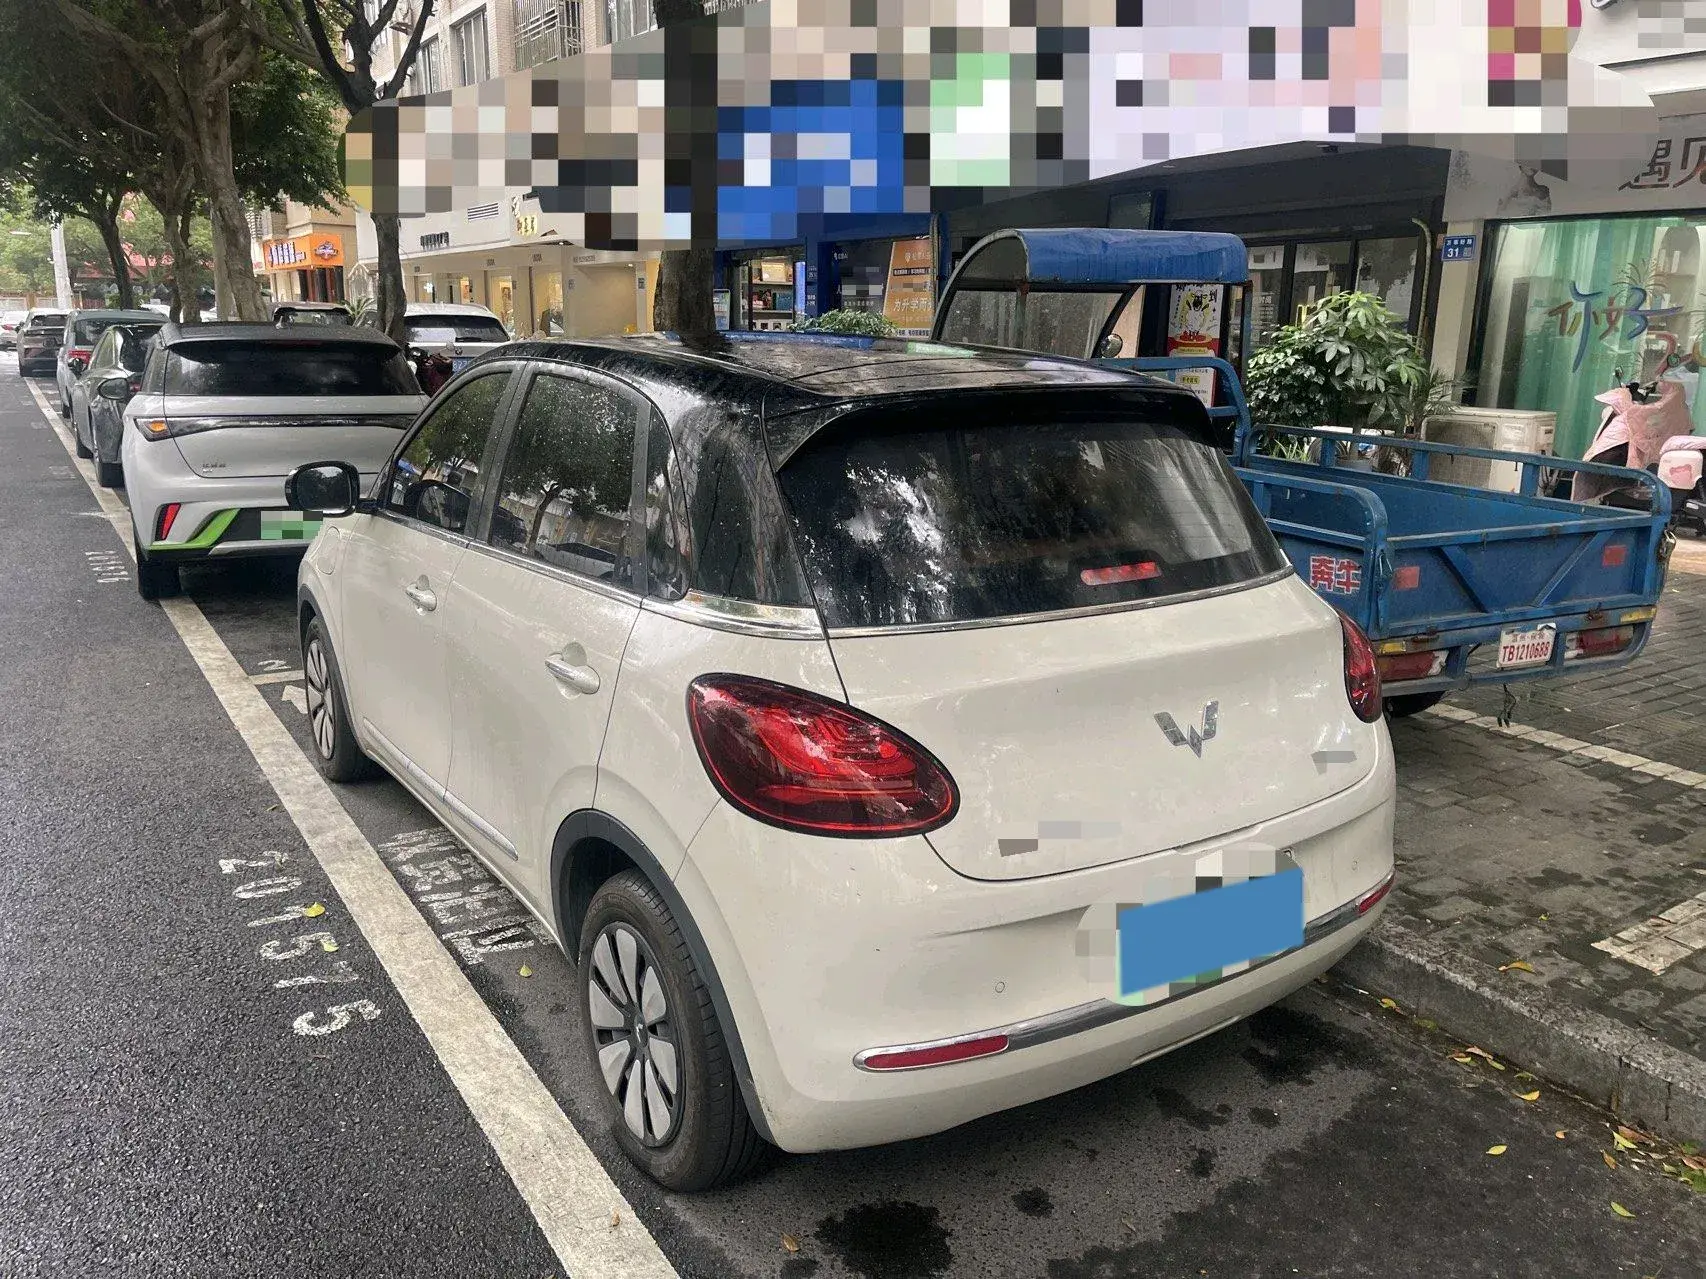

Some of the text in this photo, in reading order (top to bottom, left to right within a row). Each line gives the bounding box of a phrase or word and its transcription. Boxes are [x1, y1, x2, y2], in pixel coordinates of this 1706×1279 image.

[1447, 248, 1459, 258] 31
[1545, 281, 1684, 373] 你好
[1502, 641, 1550, 663] TB1210688
[218, 850, 382, 1037] 201575
